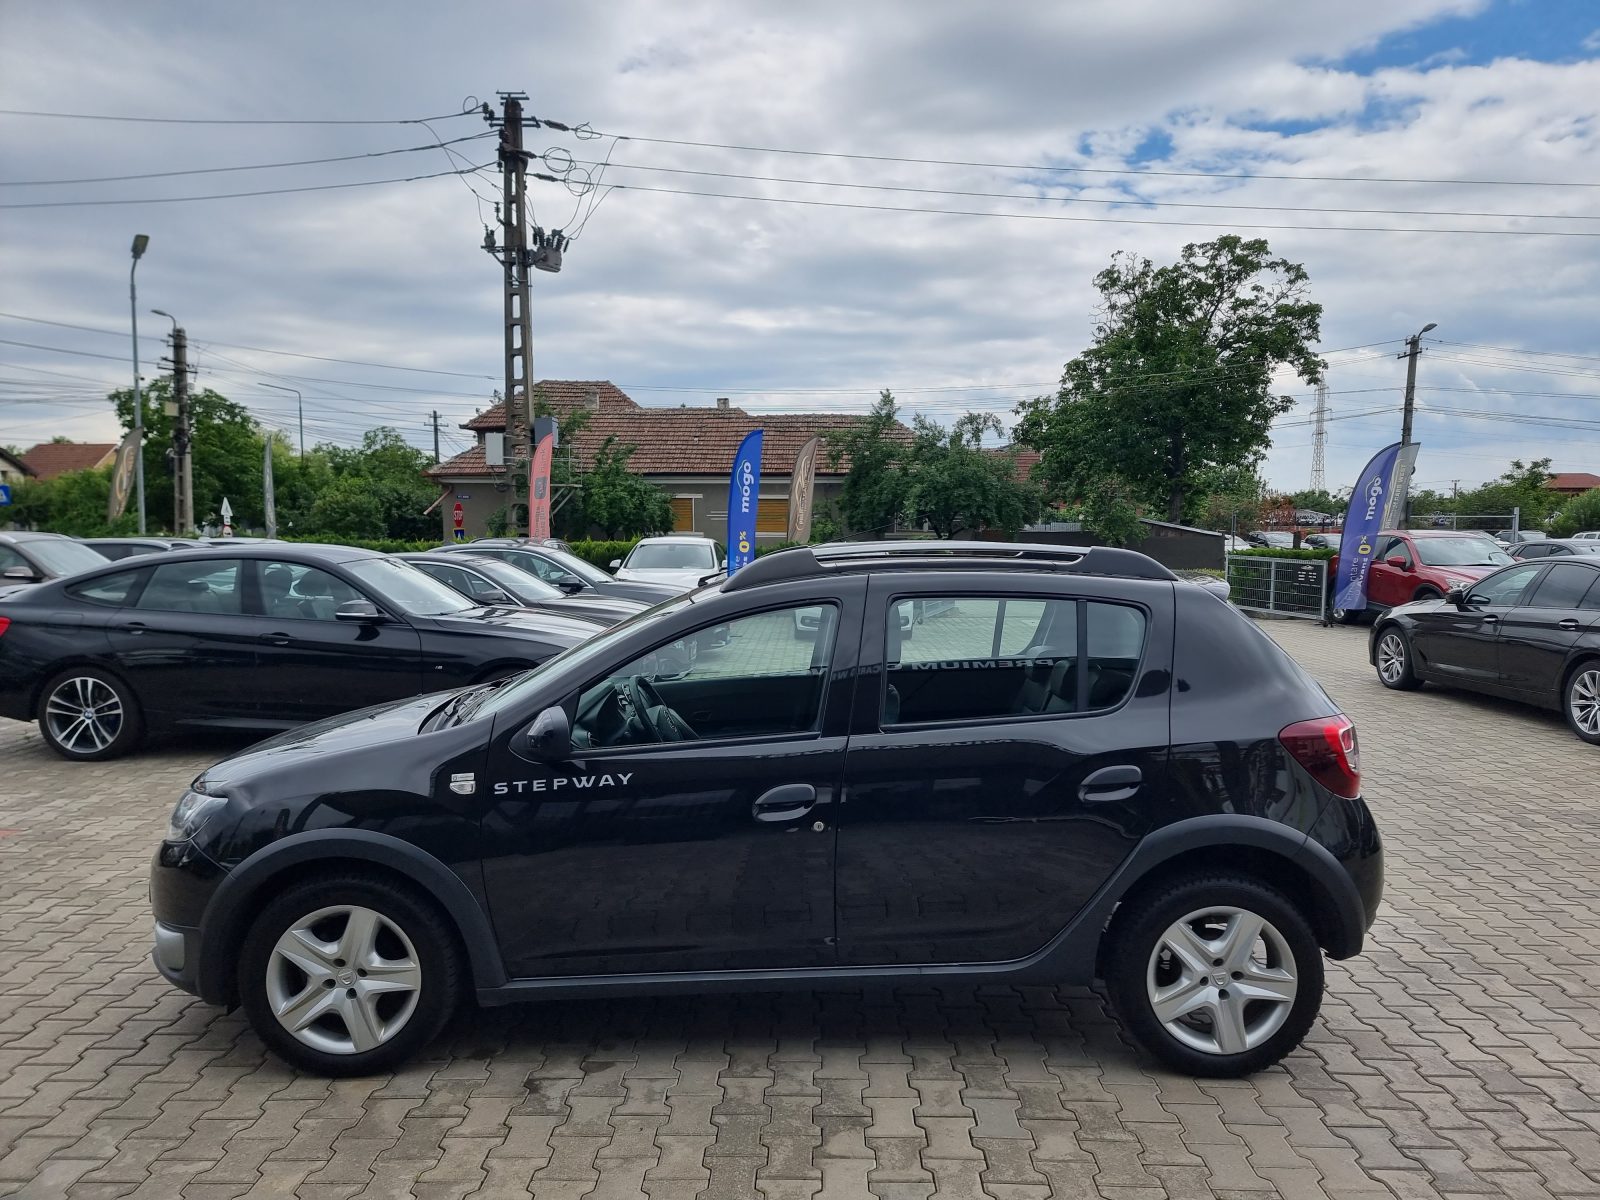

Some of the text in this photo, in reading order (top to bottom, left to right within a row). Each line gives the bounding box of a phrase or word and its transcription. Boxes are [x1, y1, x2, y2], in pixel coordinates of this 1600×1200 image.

[741, 462, 754, 513] mogo
[1365, 477, 1382, 520] mogo
[454, 511, 463, 520] STOP
[739, 531, 750, 553] 0%
[1358, 535, 1371, 555] 0%
[494, 773, 633, 795] STEPWAY
